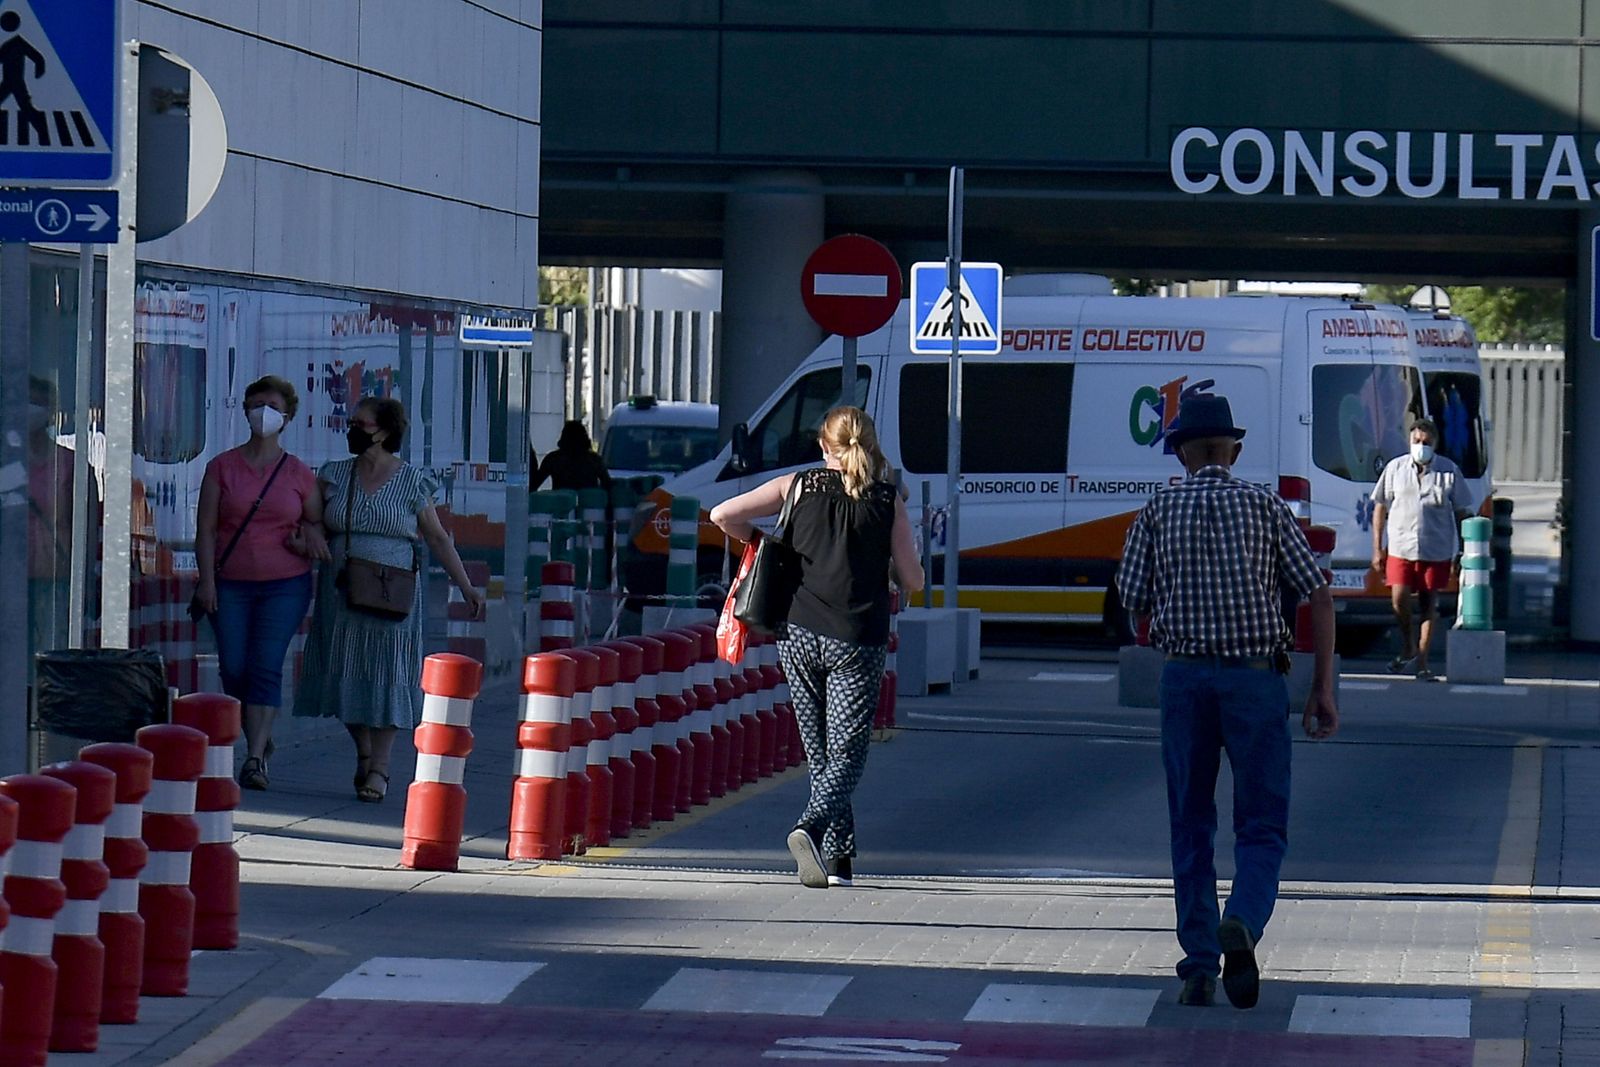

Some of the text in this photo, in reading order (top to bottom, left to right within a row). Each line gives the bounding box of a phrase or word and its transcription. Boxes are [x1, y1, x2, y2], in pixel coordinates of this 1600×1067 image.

[1170, 127, 1600, 201] CONSULTA
[1082, 328, 1205, 352] COLECTIVO
[1040, 480, 1059, 493] DE
[1067, 475, 1163, 494] TRANSPORTE
